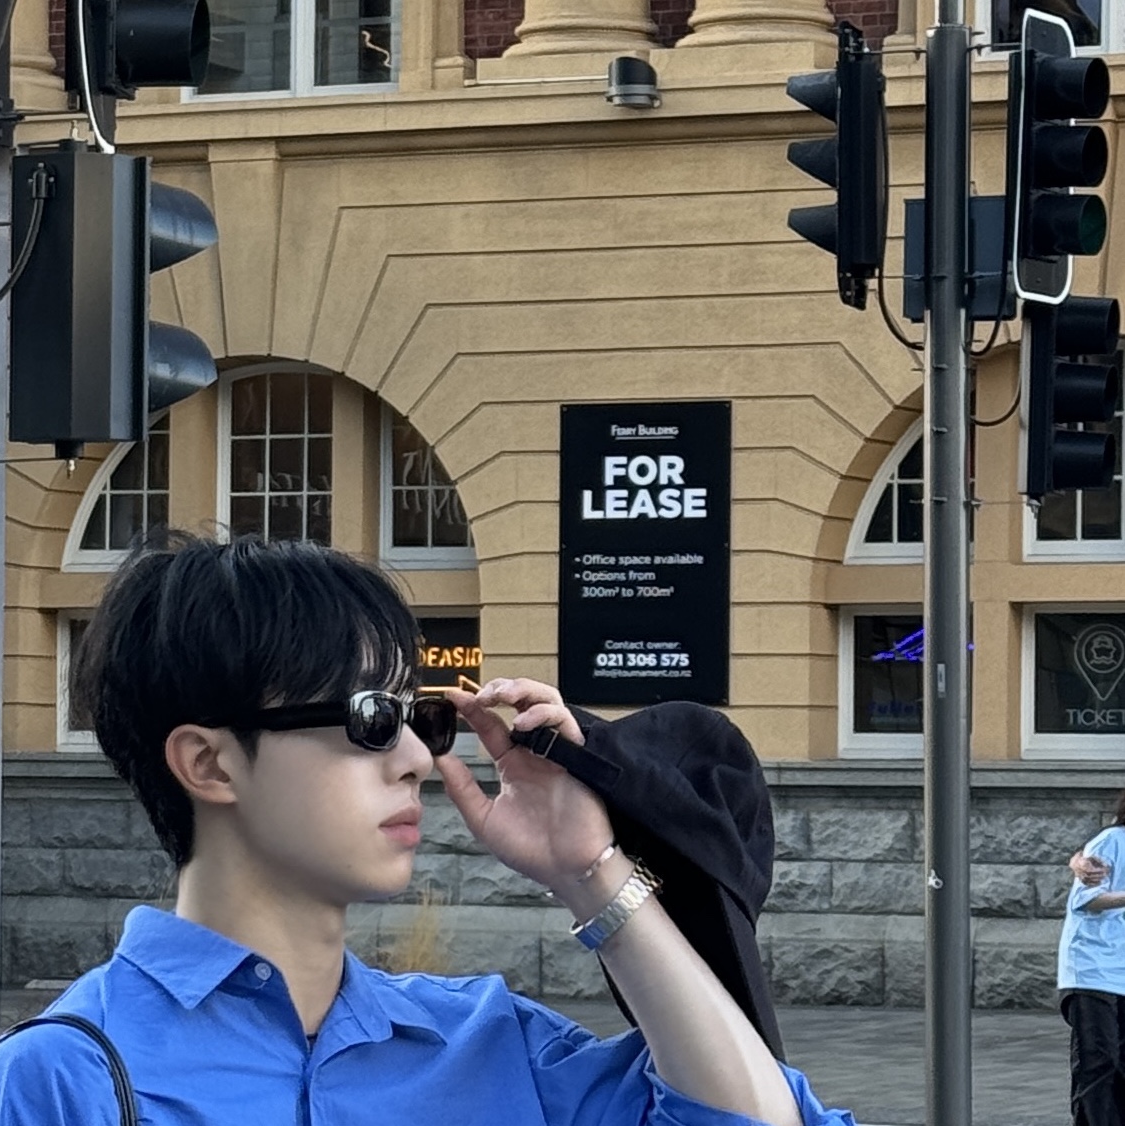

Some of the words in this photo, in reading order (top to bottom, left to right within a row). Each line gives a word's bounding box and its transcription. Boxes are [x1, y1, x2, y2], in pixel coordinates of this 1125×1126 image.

[604, 455, 685, 486] FOR
[582, 488, 707, 519] LEASE
[582, 554, 616, 565] Office
[618, 556, 652, 566] space
[653, 553, 704, 565] available
[582, 570, 626, 582] Options
[628, 570, 656, 581] from
[621, 587, 634, 597] to
[604, 640, 644, 650] Contact
[596, 653, 624, 667] 021
[626, 653, 657, 667] 306
[659, 653, 690, 667] 575
